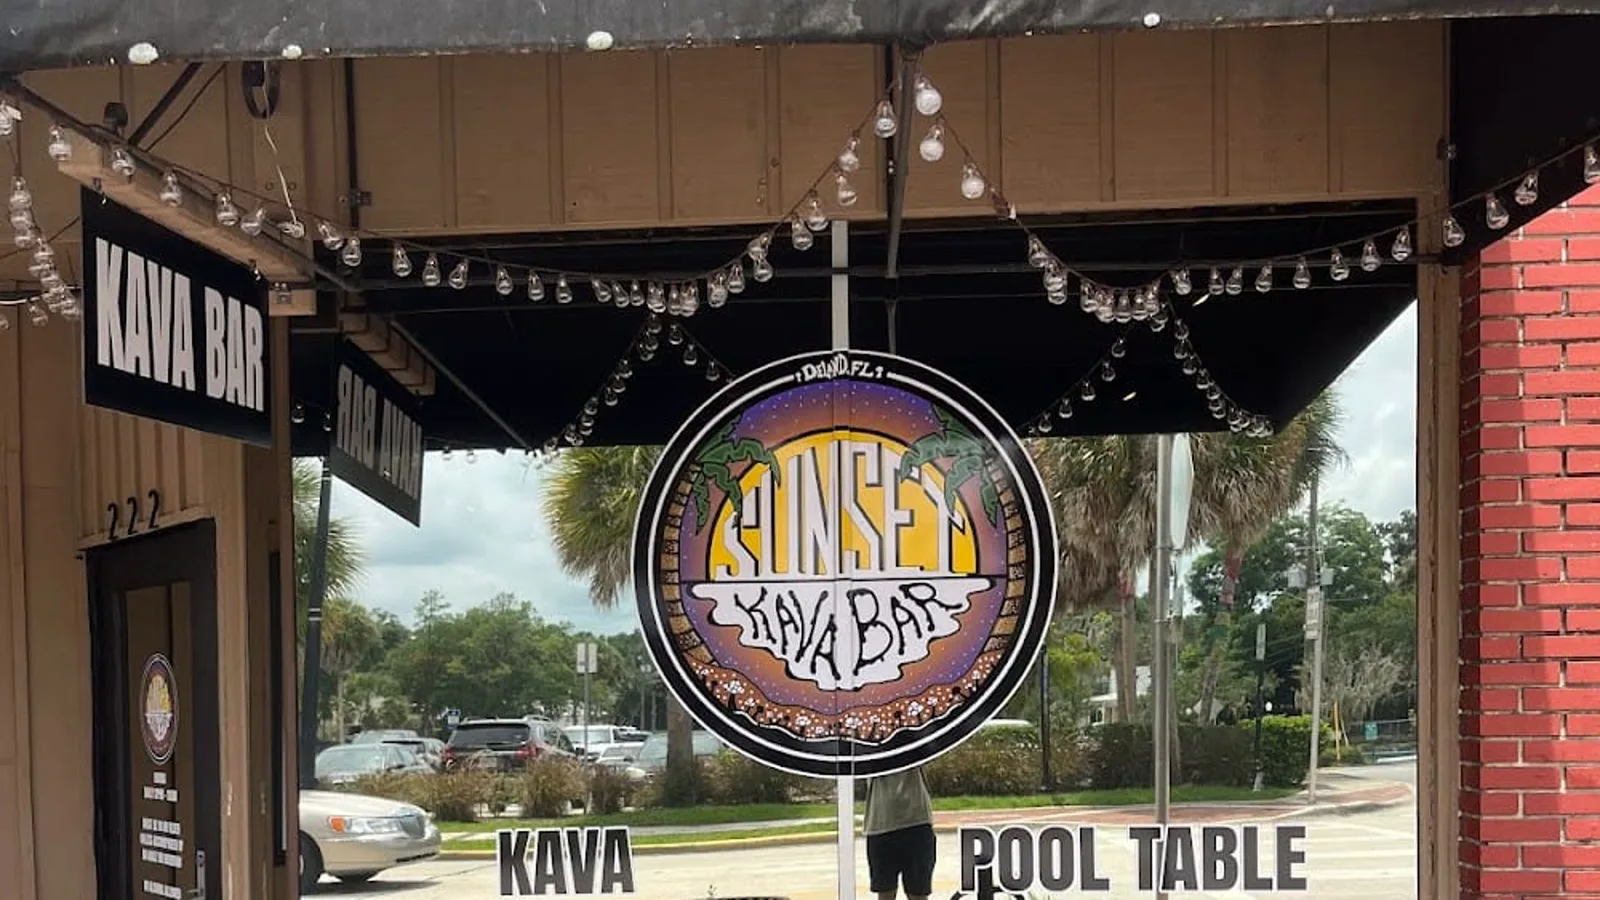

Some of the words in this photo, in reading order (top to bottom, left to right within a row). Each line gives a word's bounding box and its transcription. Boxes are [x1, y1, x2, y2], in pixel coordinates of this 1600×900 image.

[96, 237, 196, 391] KAVA
[204, 286, 264, 412] BAR
[850, 361, 875, 378] FL
[107, 489, 159, 539] 222
[733, 587, 840, 680] KAVA
[847, 583, 963, 675] BAR
[497, 827, 635, 897] KAVA
[959, 825, 1111, 892] POOL
[1128, 825, 1307, 892] TABLE
